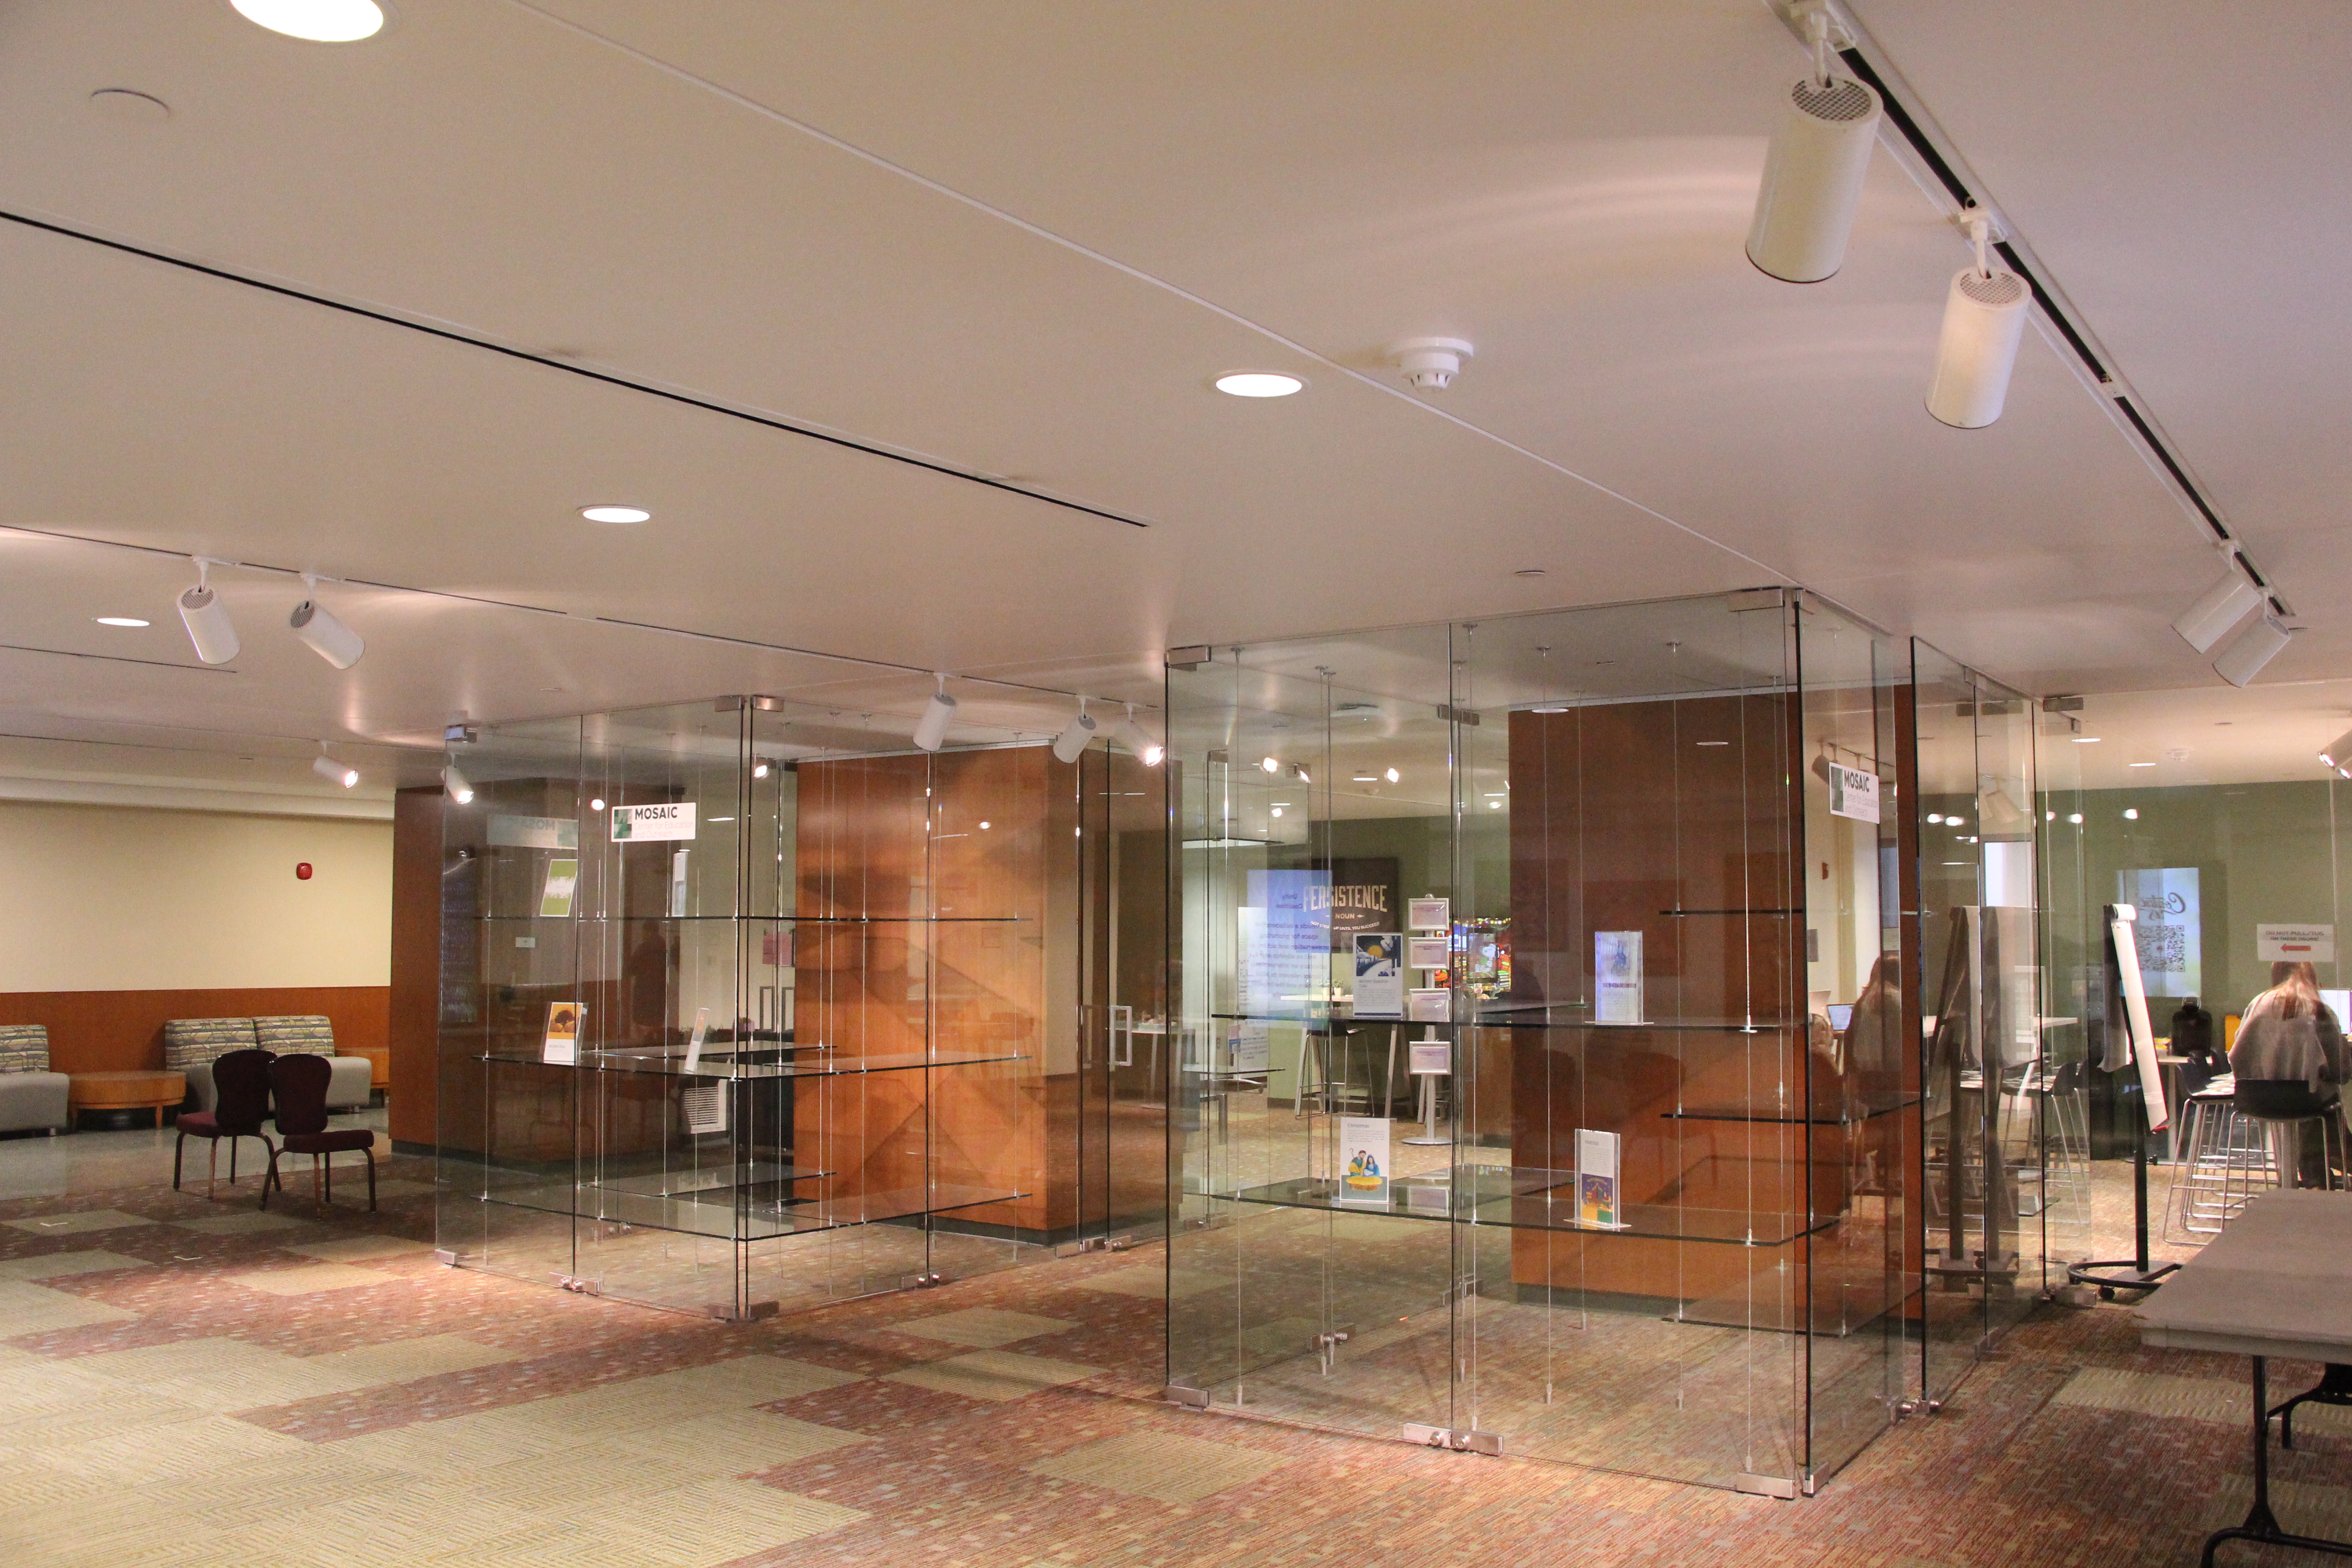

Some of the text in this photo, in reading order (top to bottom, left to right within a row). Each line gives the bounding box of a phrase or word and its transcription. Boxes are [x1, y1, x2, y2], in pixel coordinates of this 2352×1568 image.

[1844, 769, 1869, 792] MOSAIC
[635, 806, 677, 820] MOSAIC
[665, 821, 694, 829] Education
[646, 830, 673, 838] Outreach
[1360, 921, 1380, 930] SUCCEED
